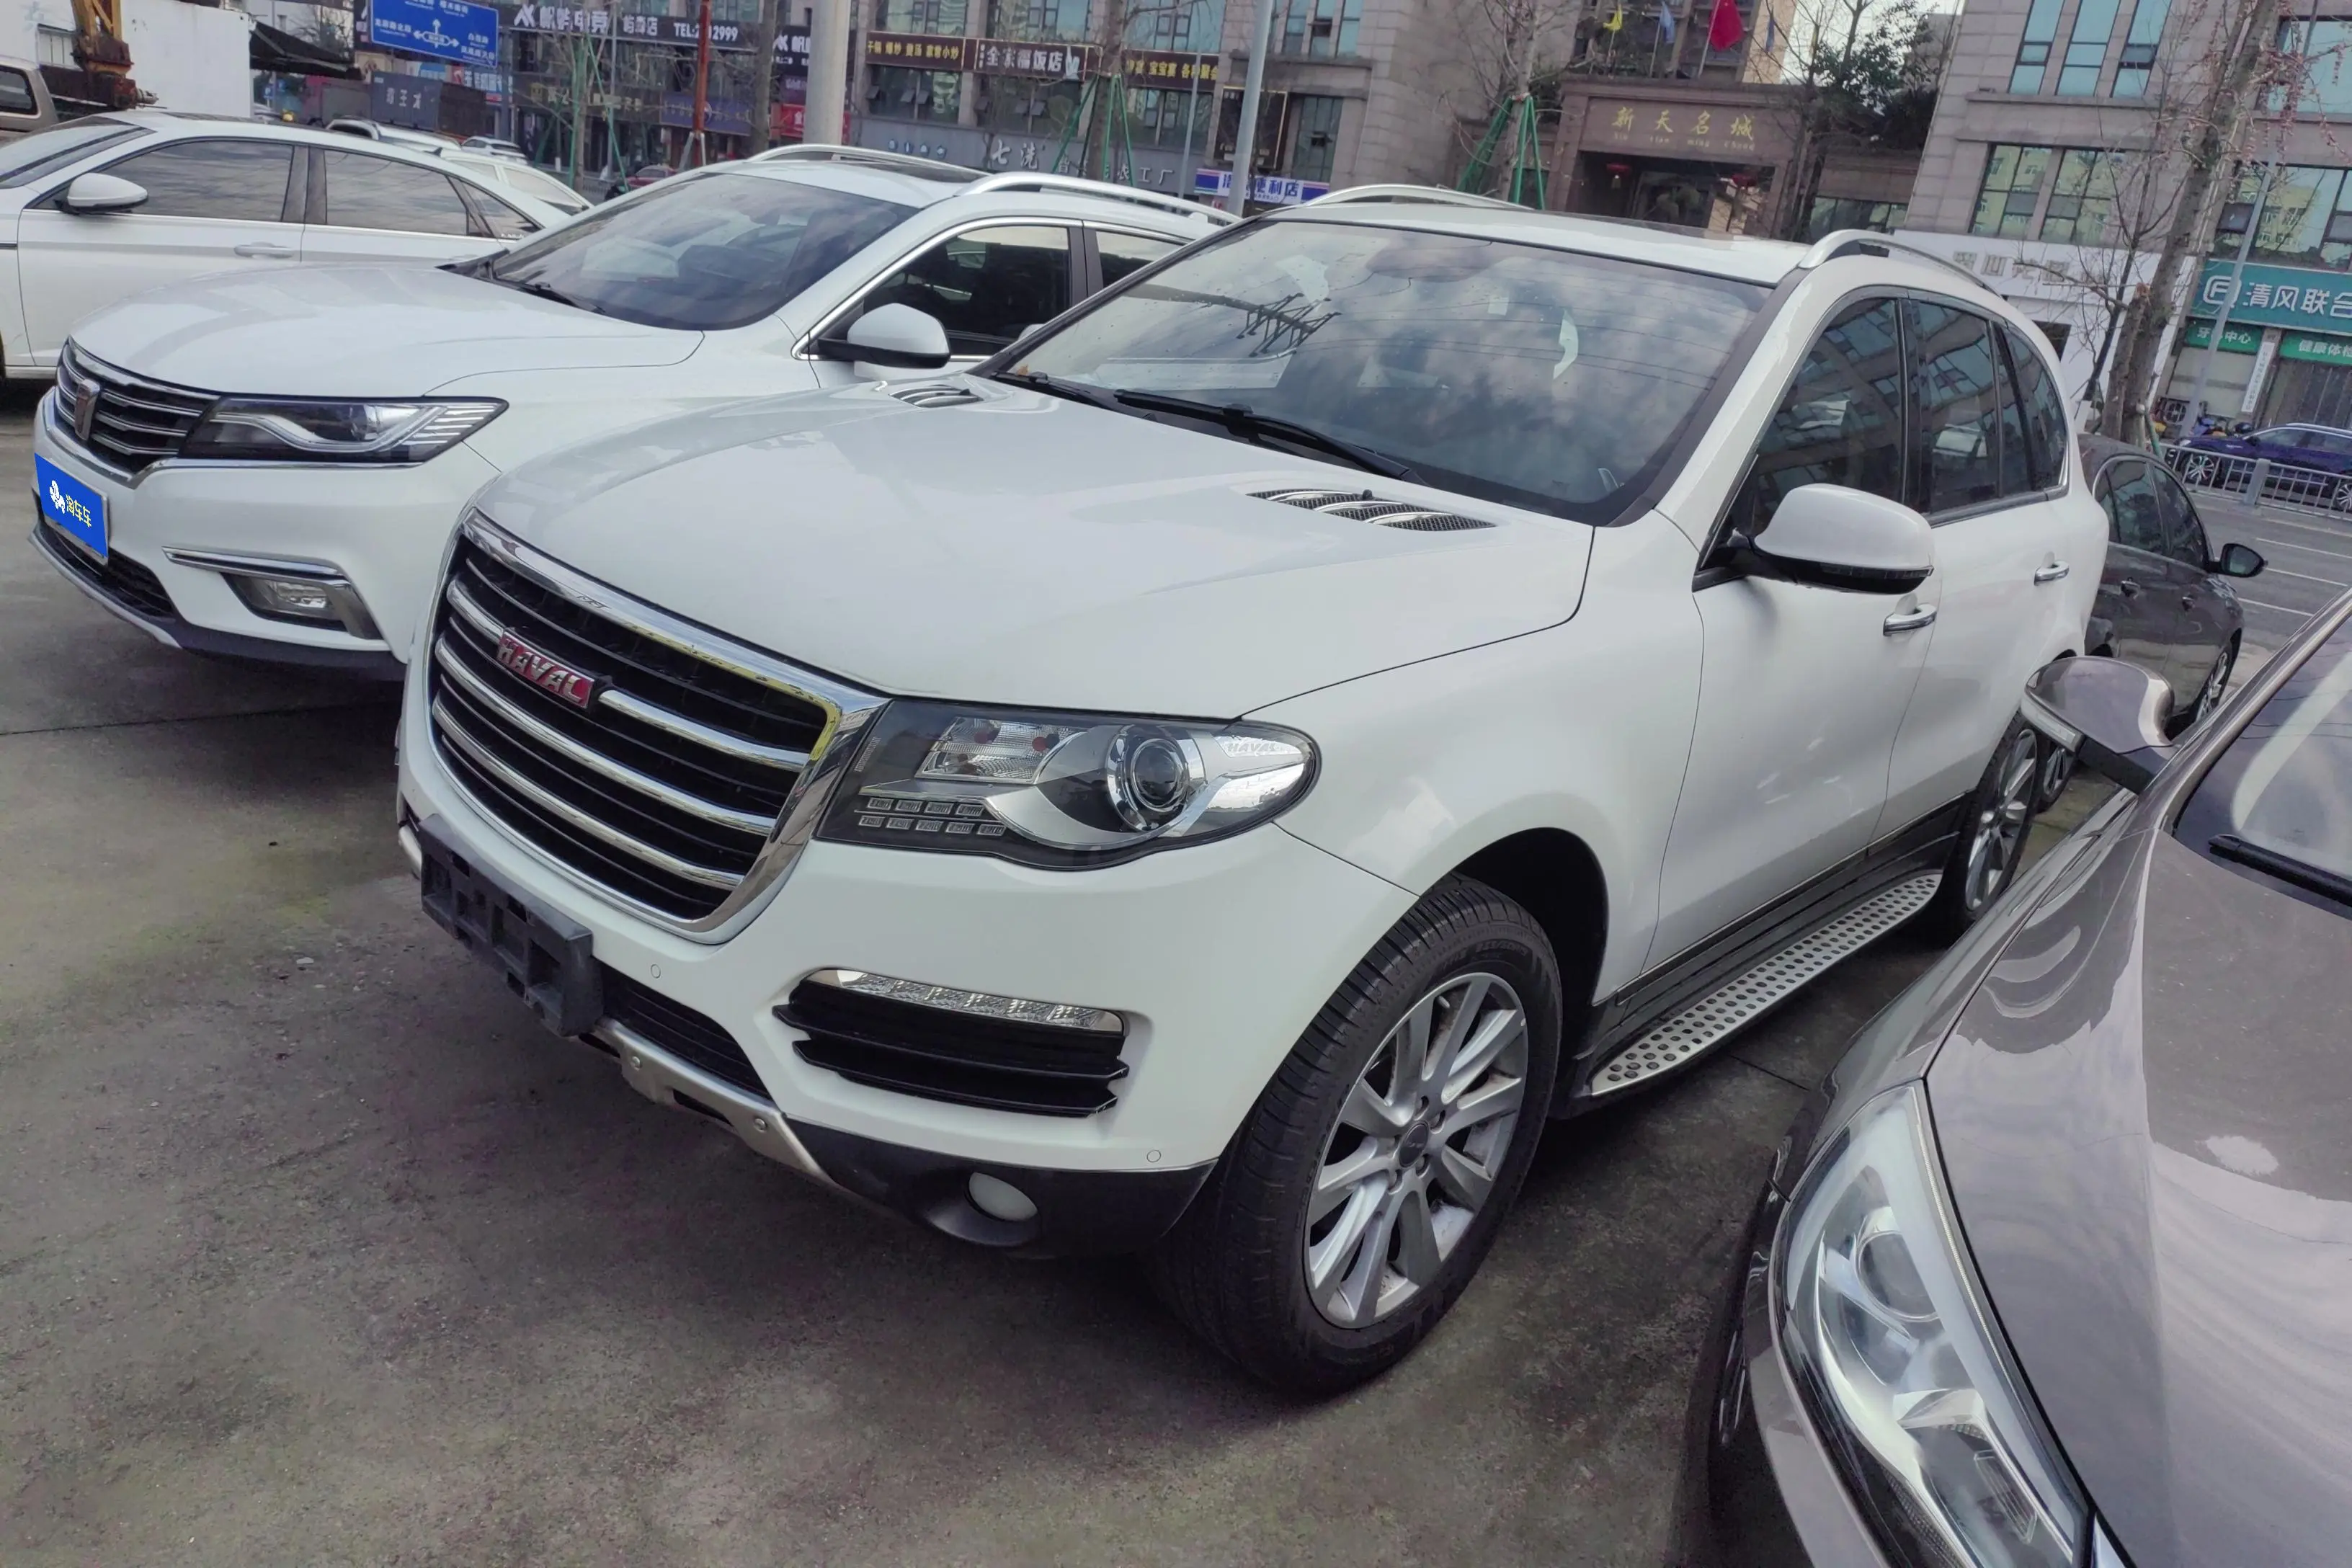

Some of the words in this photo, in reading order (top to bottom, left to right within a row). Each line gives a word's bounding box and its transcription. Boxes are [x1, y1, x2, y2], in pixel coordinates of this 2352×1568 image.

[1223, 174, 1299, 197] 便利店
[2242, 281, 2352, 319] 清风联合
[2197, 327, 2251, 344] 牙中心
[496, 637, 582, 704] HAVAL
